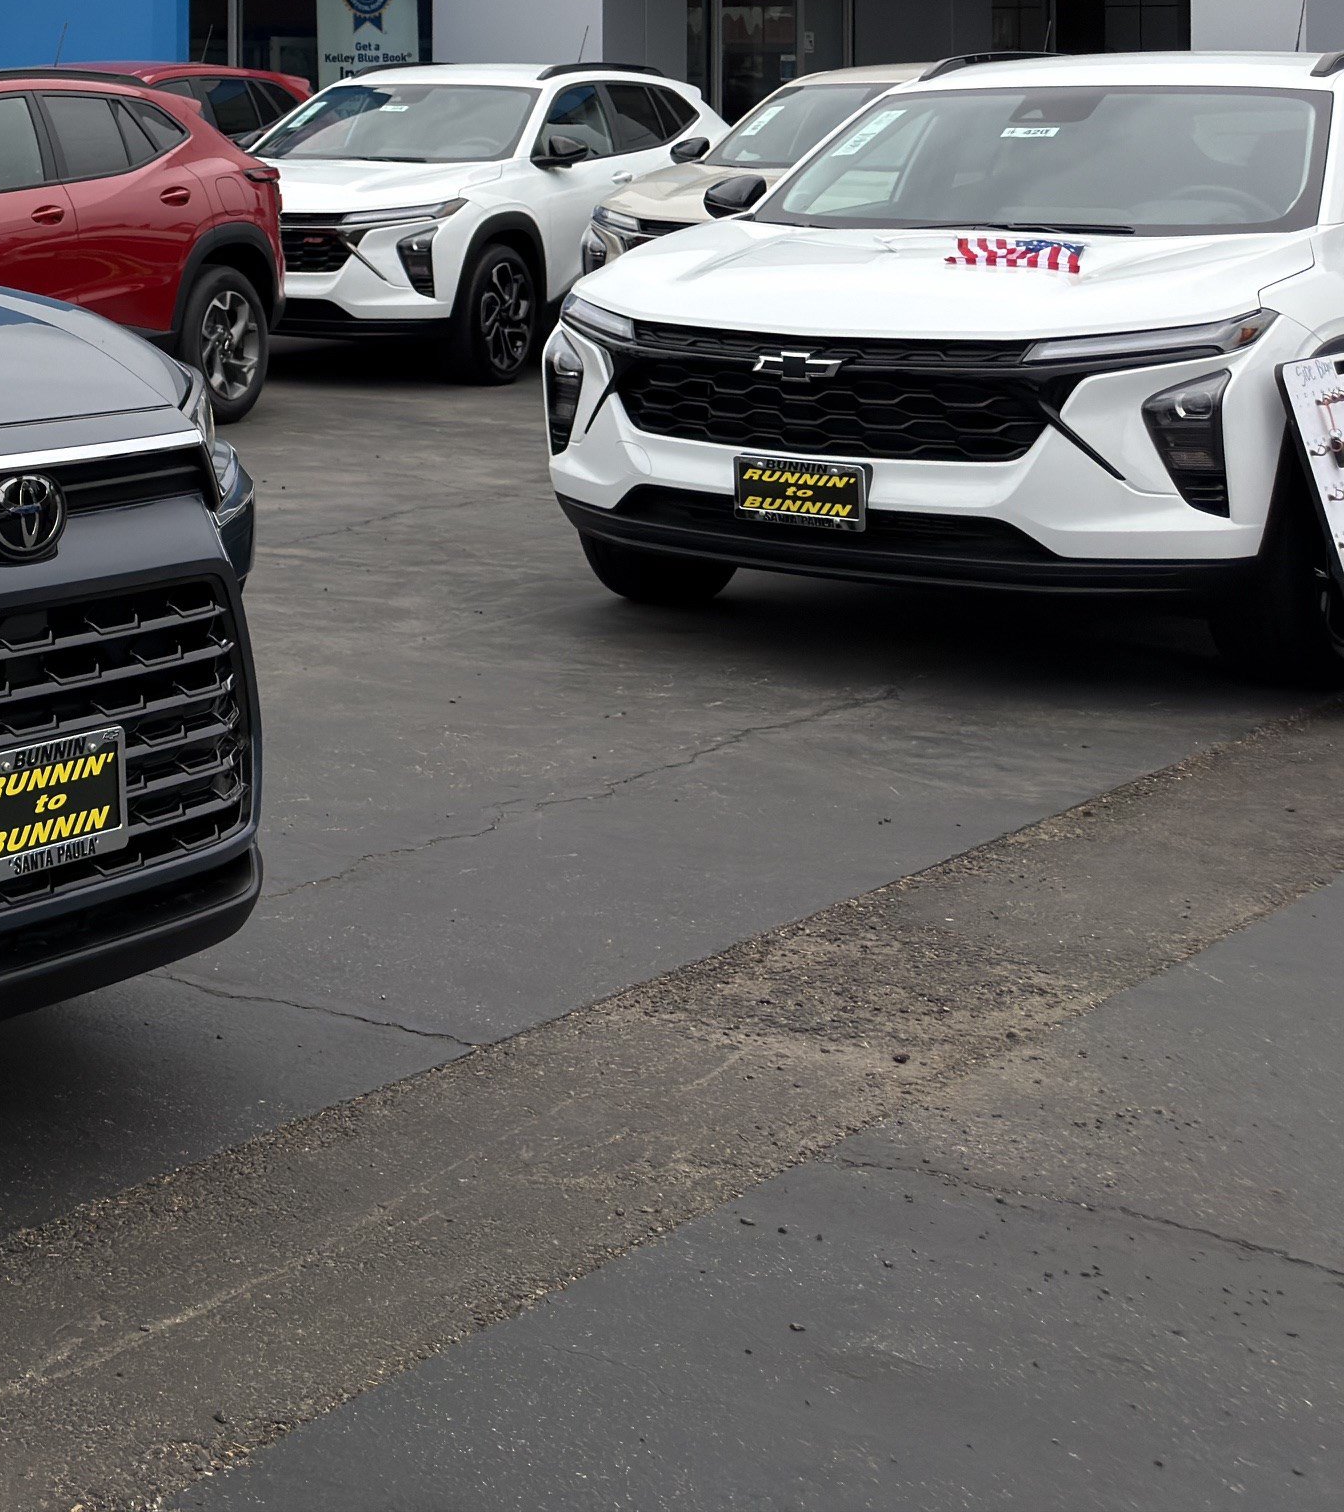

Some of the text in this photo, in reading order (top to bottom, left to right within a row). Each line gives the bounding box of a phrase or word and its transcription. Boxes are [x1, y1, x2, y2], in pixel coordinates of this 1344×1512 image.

[355, 42, 380, 51] Get a
[324, 53, 355, 64] Kelley
[357, 53, 380, 63] Blue
[766, 459, 828, 474] BUNNIN
[743, 468, 857, 488] RUNNIN'
[785, 486, 814, 497] to
[743, 495, 853, 517] BUNNIN
[13, 737, 88, 770] BUNNIN
[35, 793, 68, 814] to
